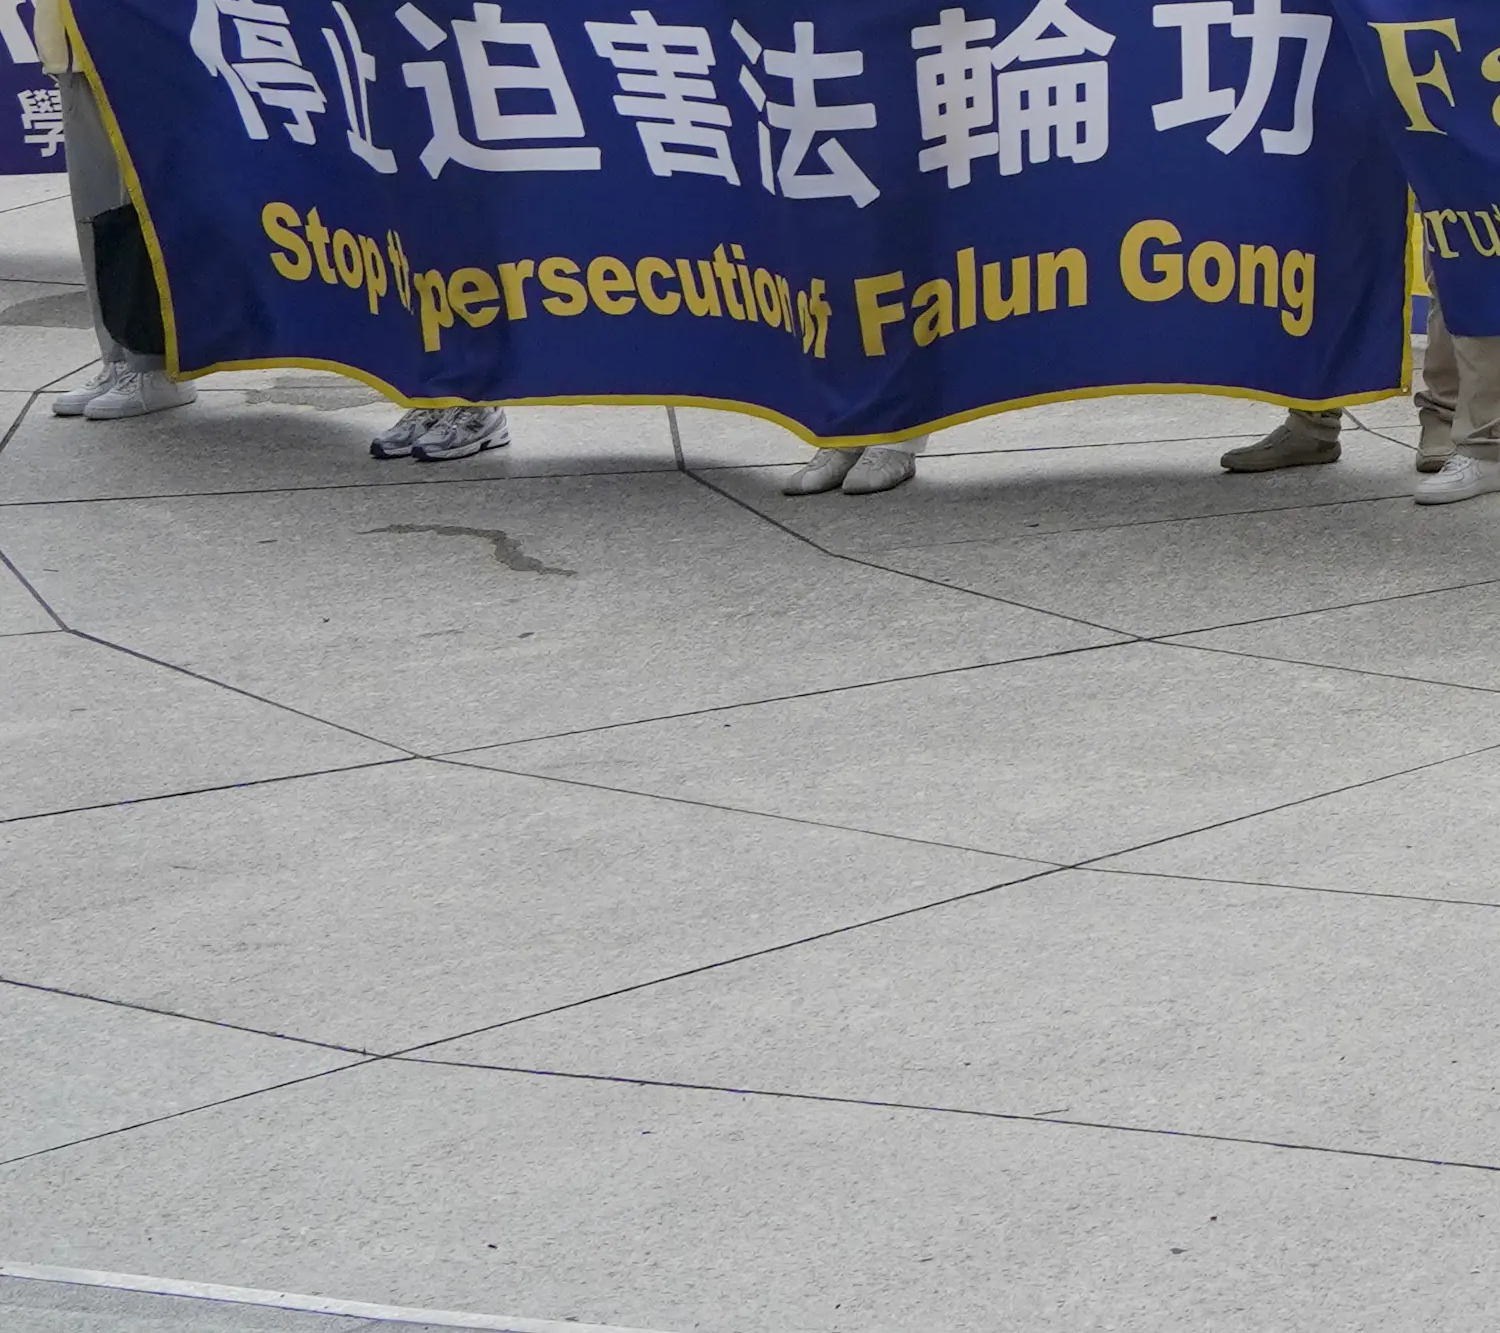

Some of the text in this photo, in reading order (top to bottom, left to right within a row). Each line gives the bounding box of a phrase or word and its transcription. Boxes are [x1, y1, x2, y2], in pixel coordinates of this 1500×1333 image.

[262, 201, 388, 314] Stop
[413, 244, 791, 353] persecution
[854, 246, 1088, 357] Falun
[1119, 219, 1315, 337] Gong
